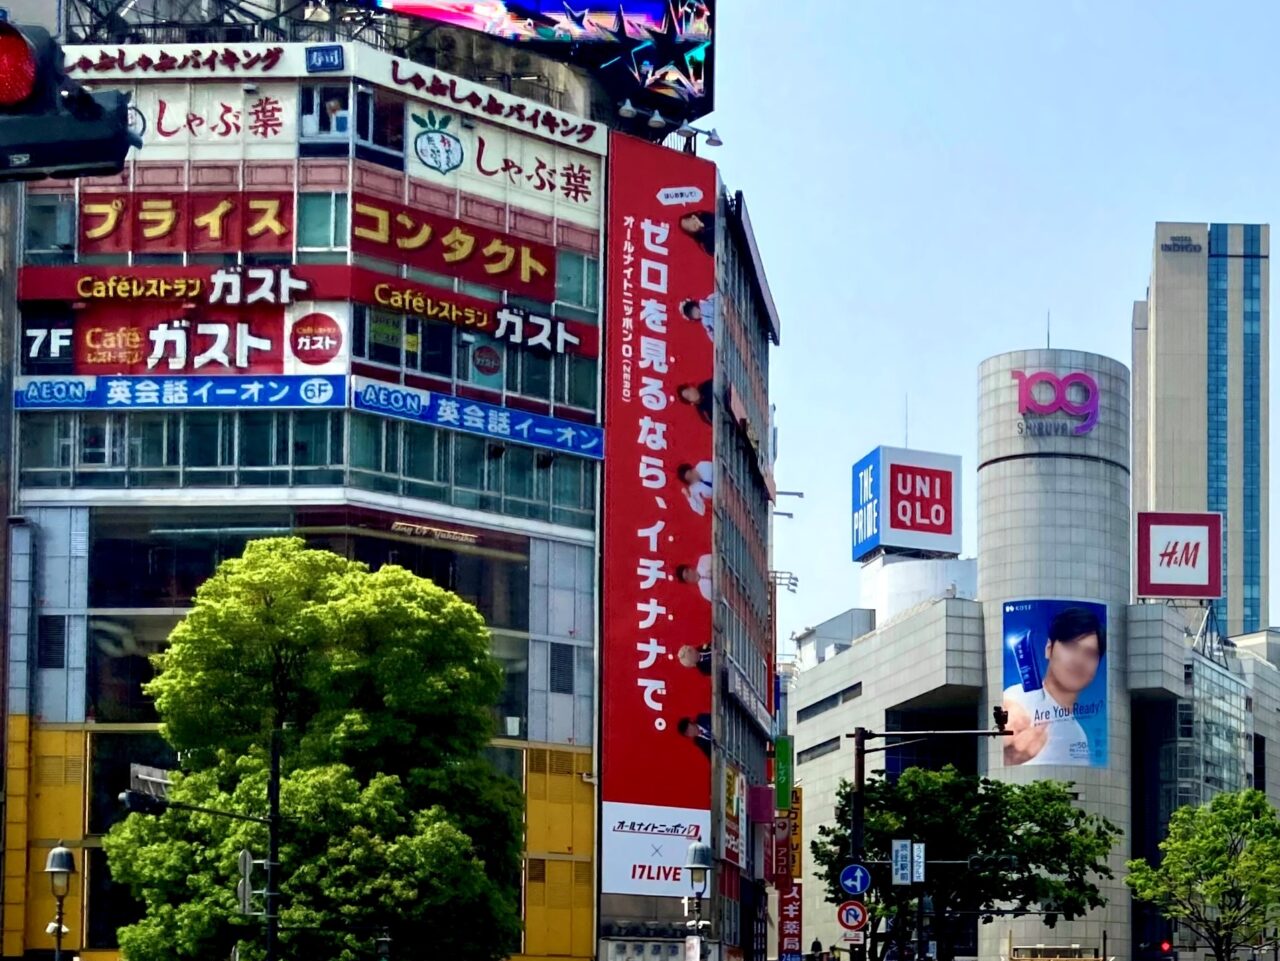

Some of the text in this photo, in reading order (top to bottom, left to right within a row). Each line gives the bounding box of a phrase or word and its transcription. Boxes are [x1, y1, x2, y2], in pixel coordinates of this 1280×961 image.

[157, 97, 283, 138] しゃぶ葉
[476, 137, 592, 203] しゃぶ葉
[84, 200, 288, 240] プライス
[354, 203, 548, 283] コンタクト
[209, 267, 308, 304] ガスト
[25, 328, 74, 357] 7F
[147, 320, 272, 370] ガスト
[297, 336, 338, 350] ガスト
[495, 305, 581, 354] ガスト
[26, 381, 86, 400] AEON
[107, 379, 332, 404] 英会話イーオン 6F
[361, 384, 424, 415] AEON
[1011, 370, 1099, 436] 109
[437, 398, 600, 450] 英会話イーオン
[637, 218, 671, 731] ゼロを見るなら、イチナナで。
[858, 464, 874, 501] THE
[897, 471, 942, 500] UNI
[853, 498, 879, 547] PRIME
[897, 499, 946, 527] QLO
[1159, 539, 1201, 569] H&M
[1034, 708, 1050, 721] Are
[1053, 705, 1071, 719] You
[631, 864, 683, 882] 17LIVE
[783, 886, 800, 950] スギ薬局
